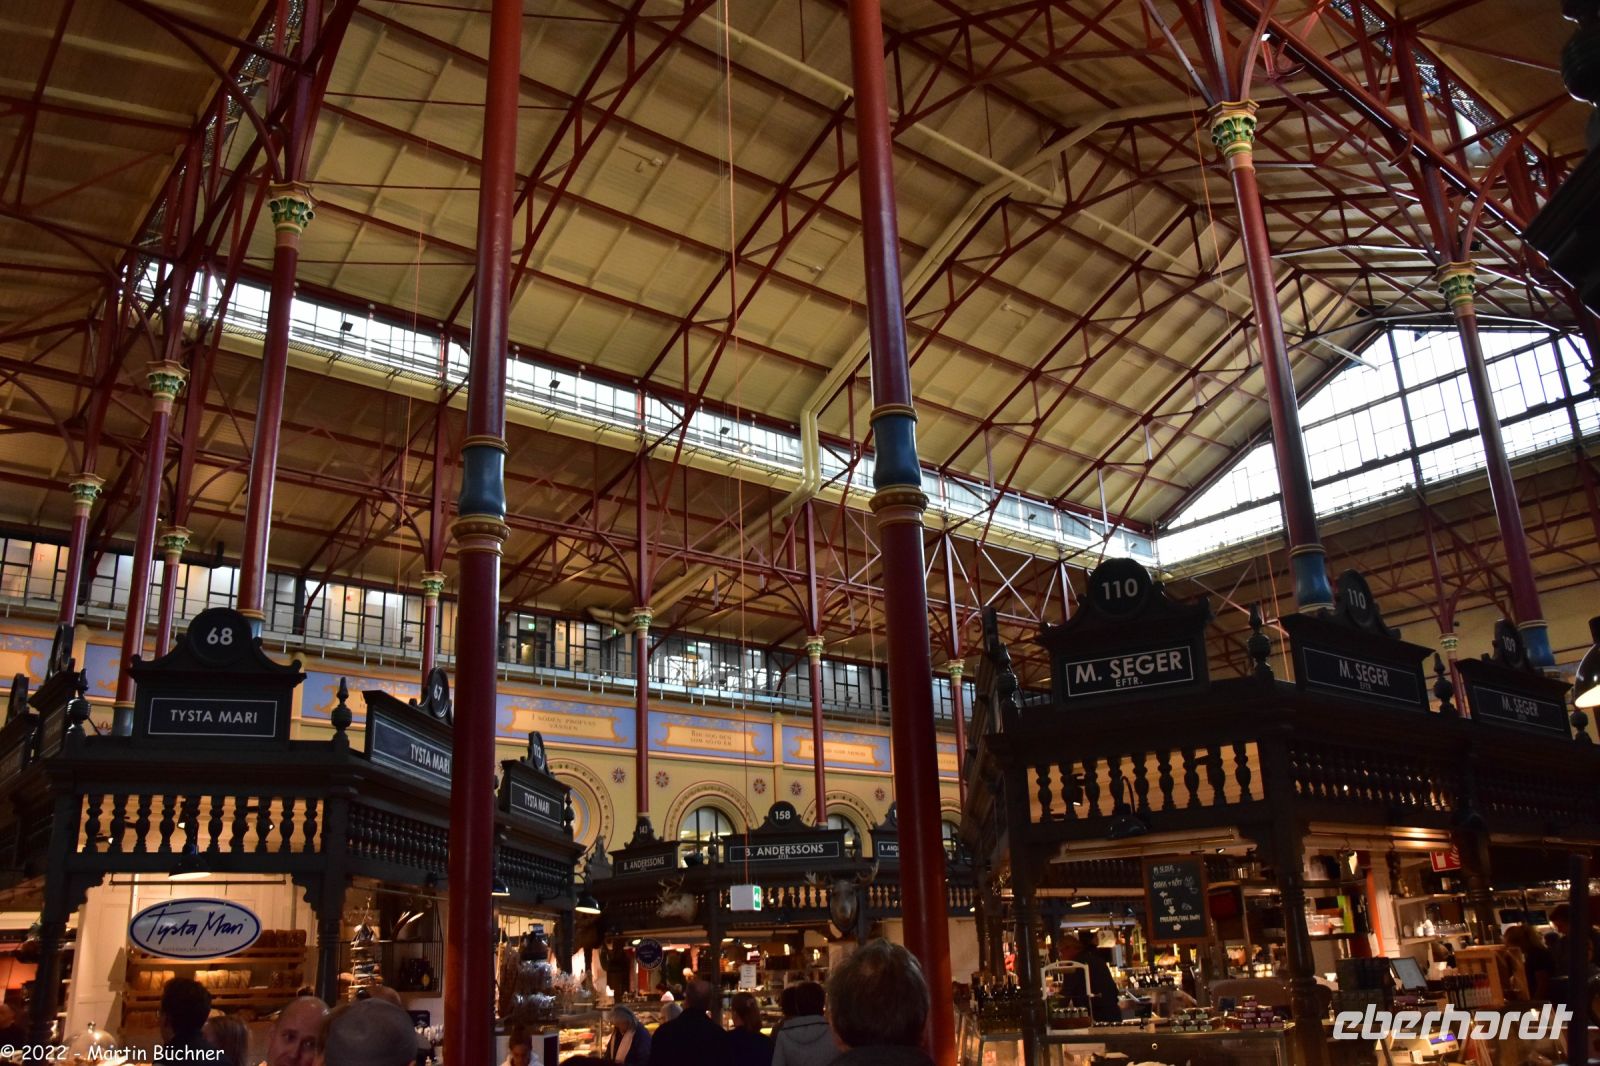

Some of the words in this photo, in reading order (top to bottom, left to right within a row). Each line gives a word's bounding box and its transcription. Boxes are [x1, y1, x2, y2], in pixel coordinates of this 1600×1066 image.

[1101, 578, 1139, 601] 110
[1347, 588, 1367, 610] 110
[206, 627, 233, 646] 68
[1075, 663, 1103, 684] M.
[1109, 650, 1183, 679] SEGER
[1339, 659, 1354, 680] M.
[1355, 663, 1391, 687] SEGER
[433, 684, 443, 701] 67
[1115, 677, 1144, 688] EFTR.
[170, 709, 214, 723] TYSTA
[218, 711, 259, 724] MARI
[1501, 695, 1513, 712] M.
[1513, 698, 1539, 718] SEGER
[410, 743, 431, 767] TYSTA
[432, 753, 450, 774] MARI
[533, 743, 542, 759] 112
[524, 792, 538, 810] TYSTA
[538, 798, 550, 815] MARI
[775, 810, 791, 820] 158
[745, 847, 755, 858] B.
[756, 844, 825, 857] ANDERSSONS
[630, 856, 665, 870] ANDERSSONS
[147, 908, 198, 945] Tysta
[194, 911, 247, 947] Mari
